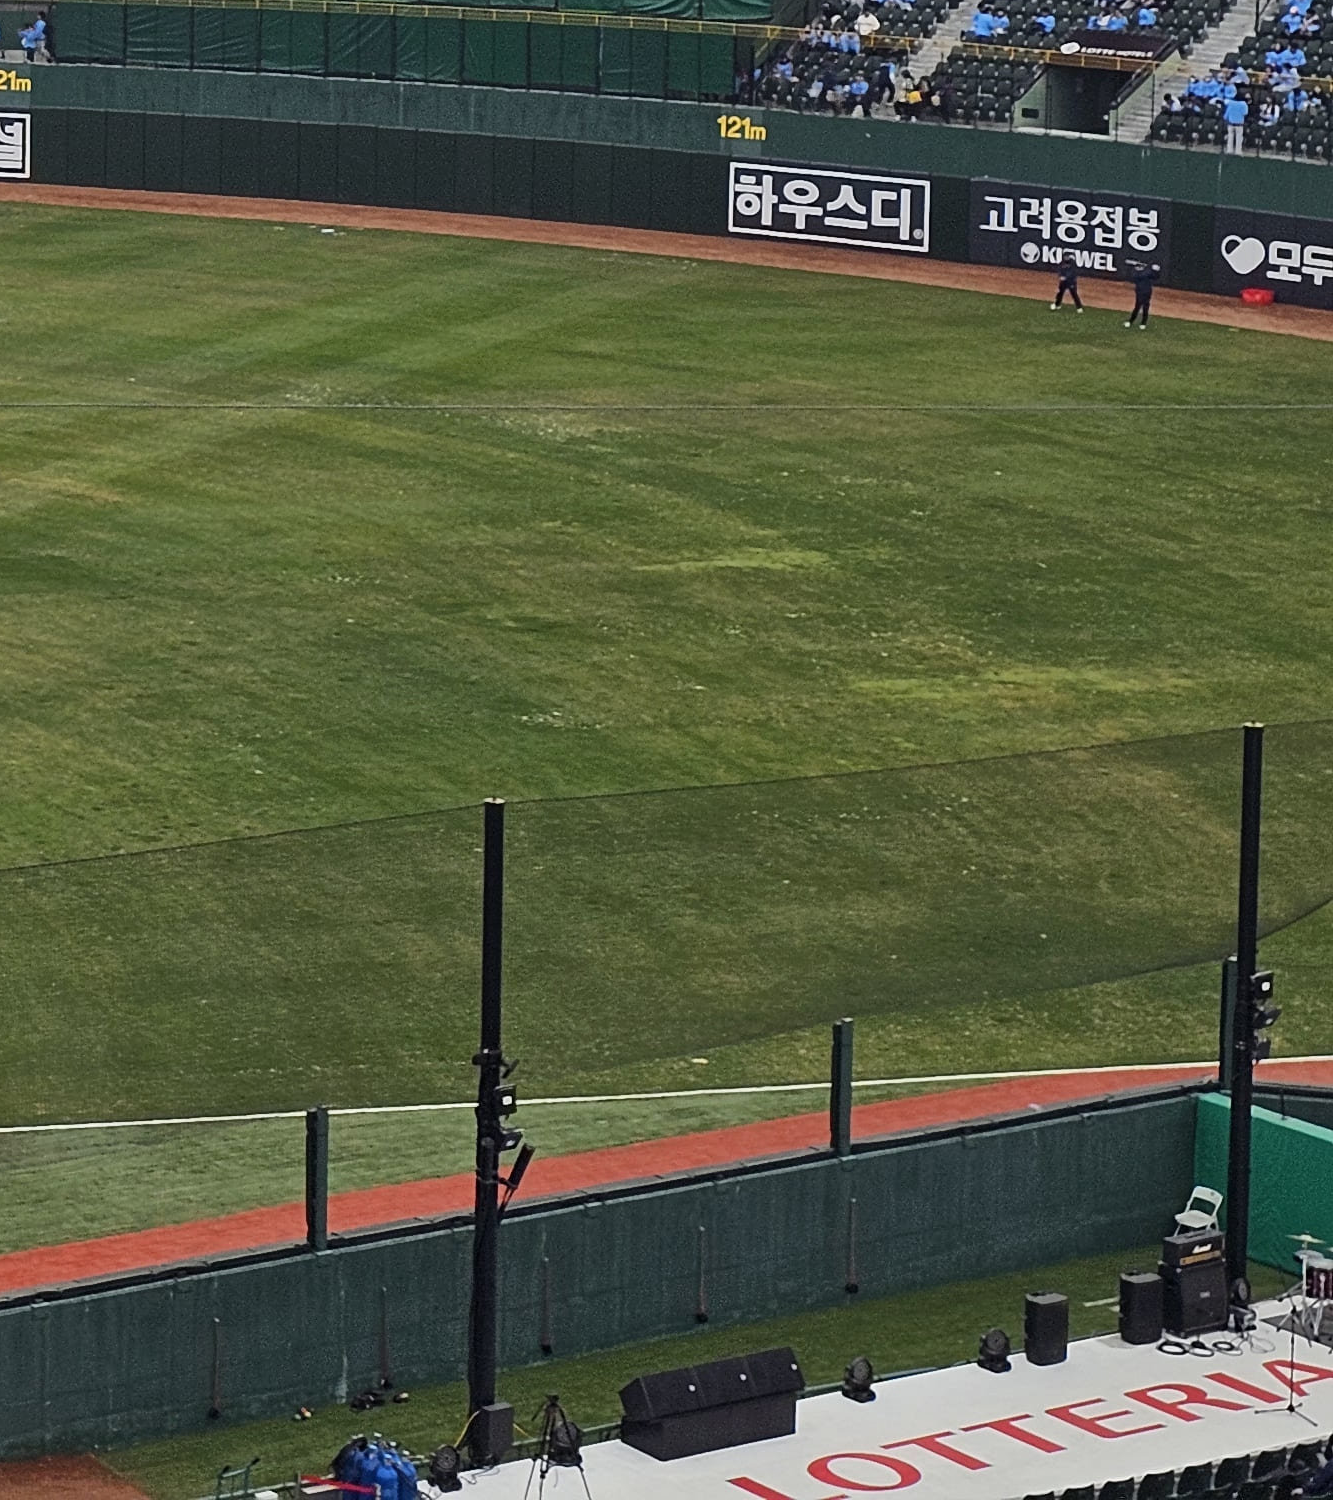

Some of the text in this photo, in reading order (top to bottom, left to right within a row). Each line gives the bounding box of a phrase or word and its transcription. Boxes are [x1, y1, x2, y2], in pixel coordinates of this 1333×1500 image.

[717, 116, 766, 142] 121m
[735, 174, 913, 241] 하우스디
[979, 196, 1161, 252] 고려용접봉
